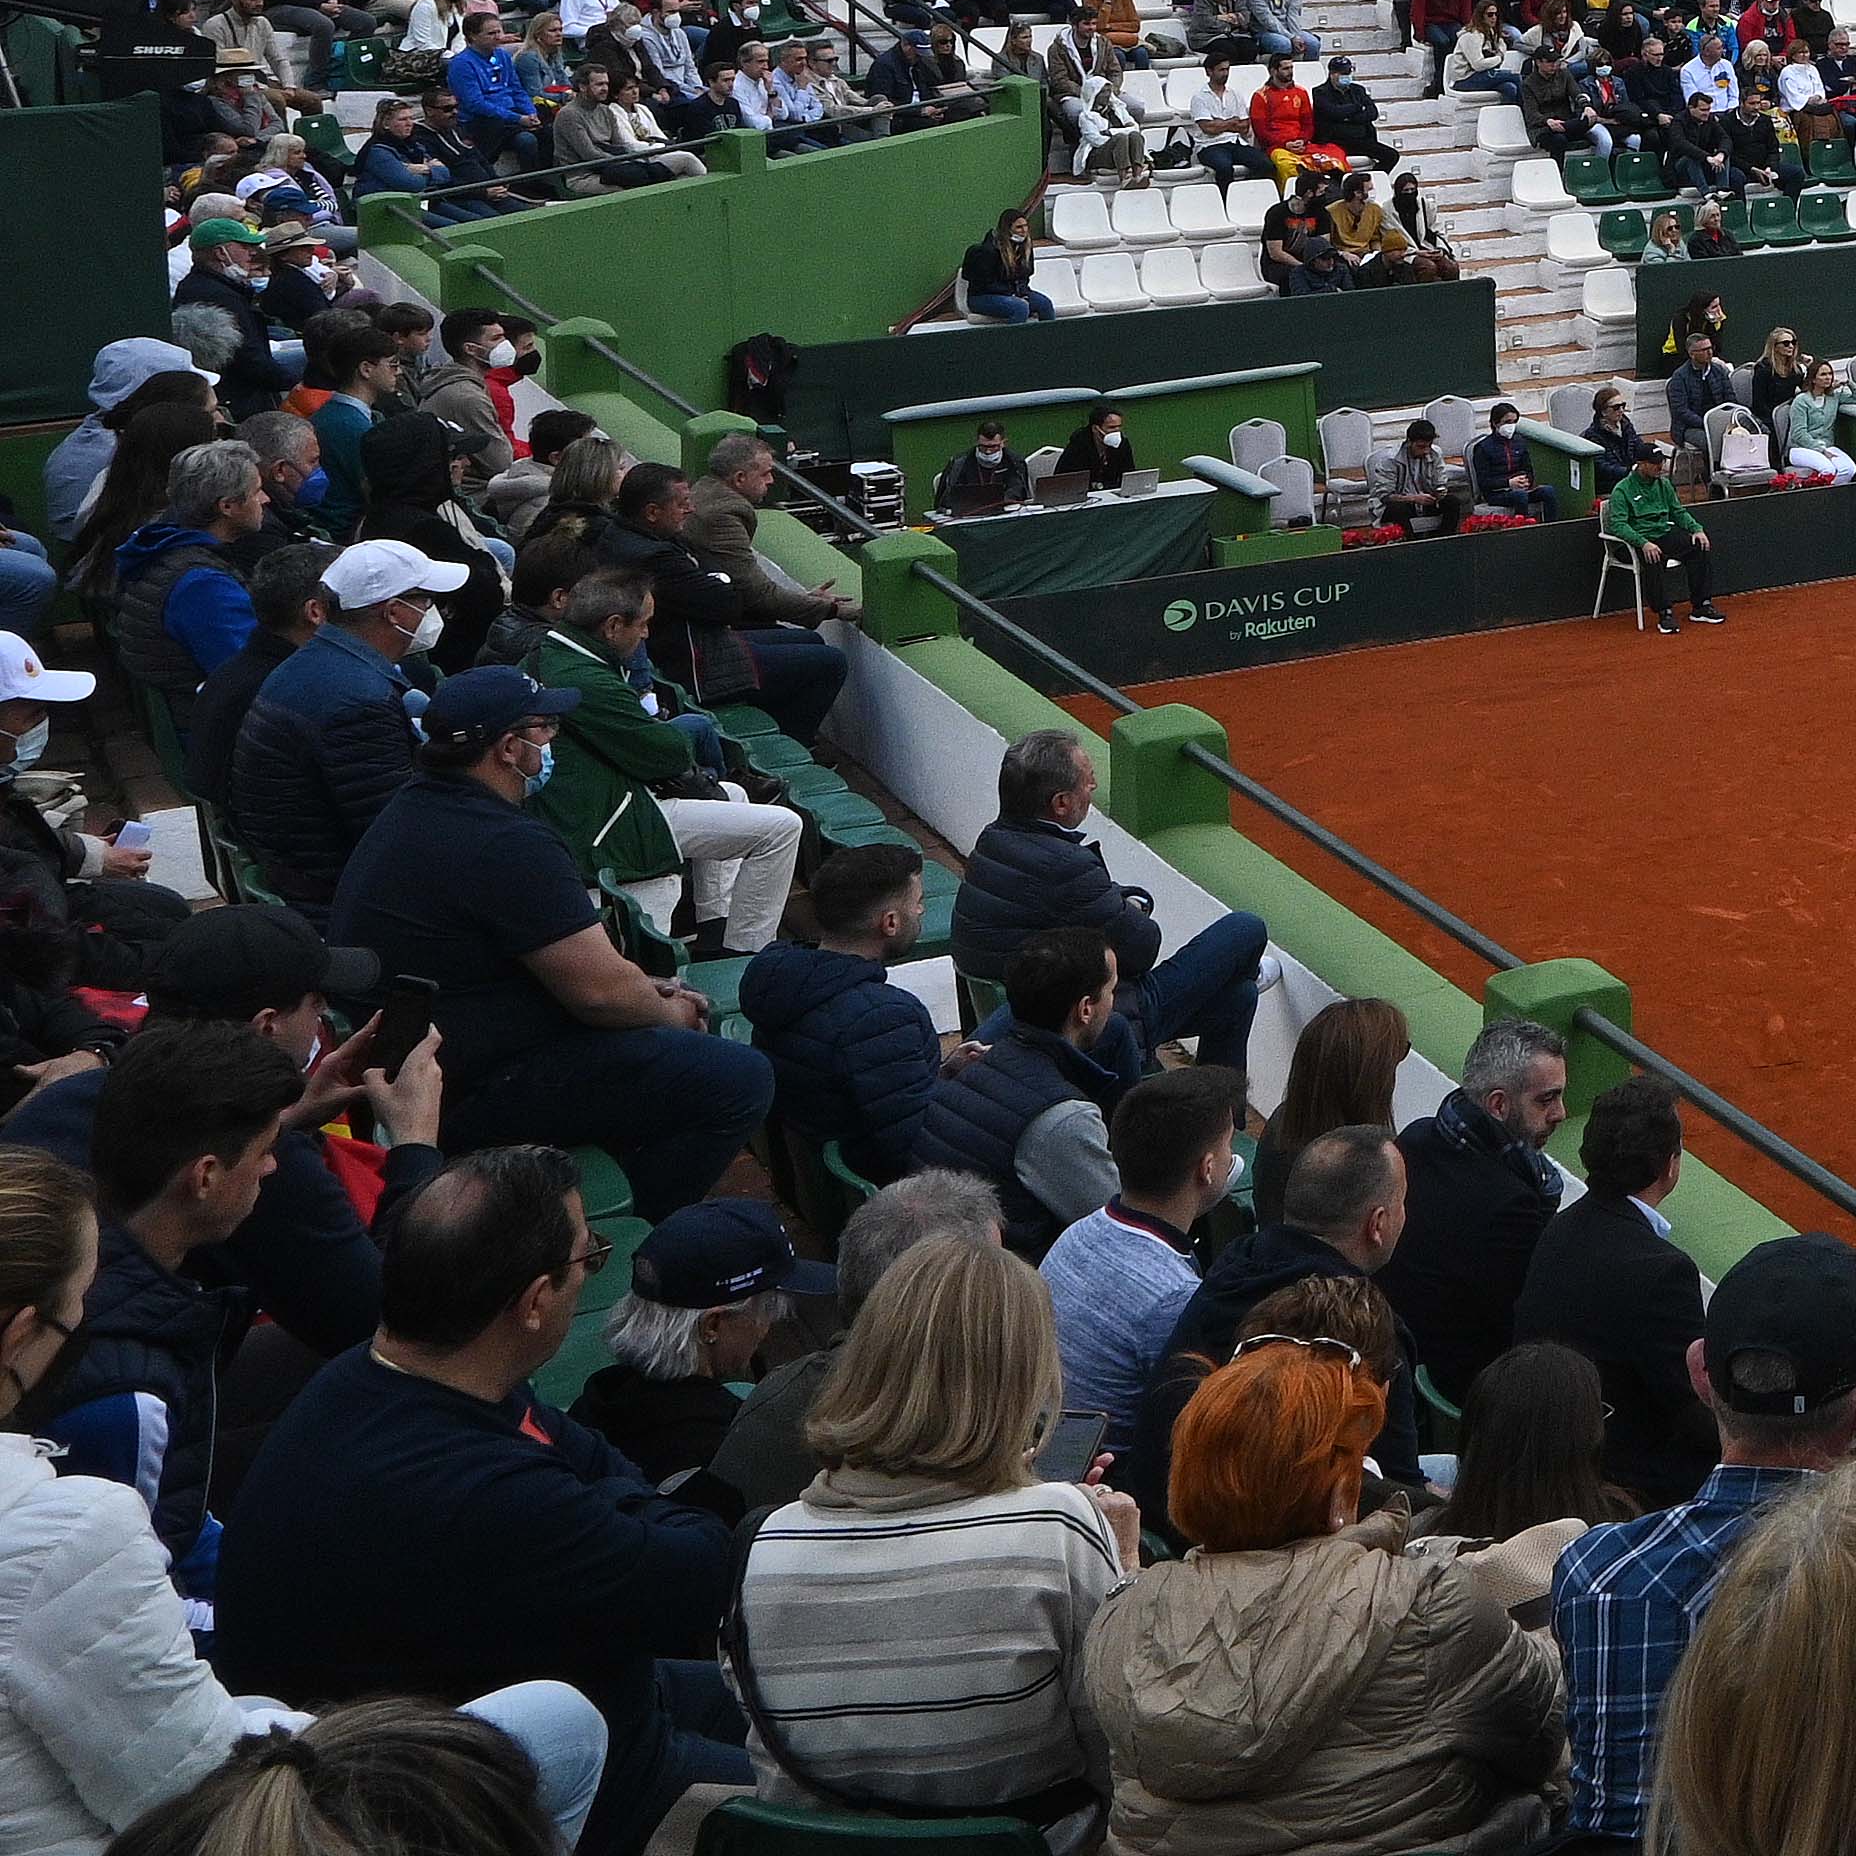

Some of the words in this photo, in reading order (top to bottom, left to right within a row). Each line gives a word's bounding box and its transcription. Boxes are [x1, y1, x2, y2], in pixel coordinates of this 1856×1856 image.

[132, 46, 185, 55] SHURE
[1205, 591, 1286, 621] DAVIS
[1293, 583, 1351, 607] CUP
[1229, 631, 1242, 641] by
[1245, 615, 1316, 638] Rakuten
